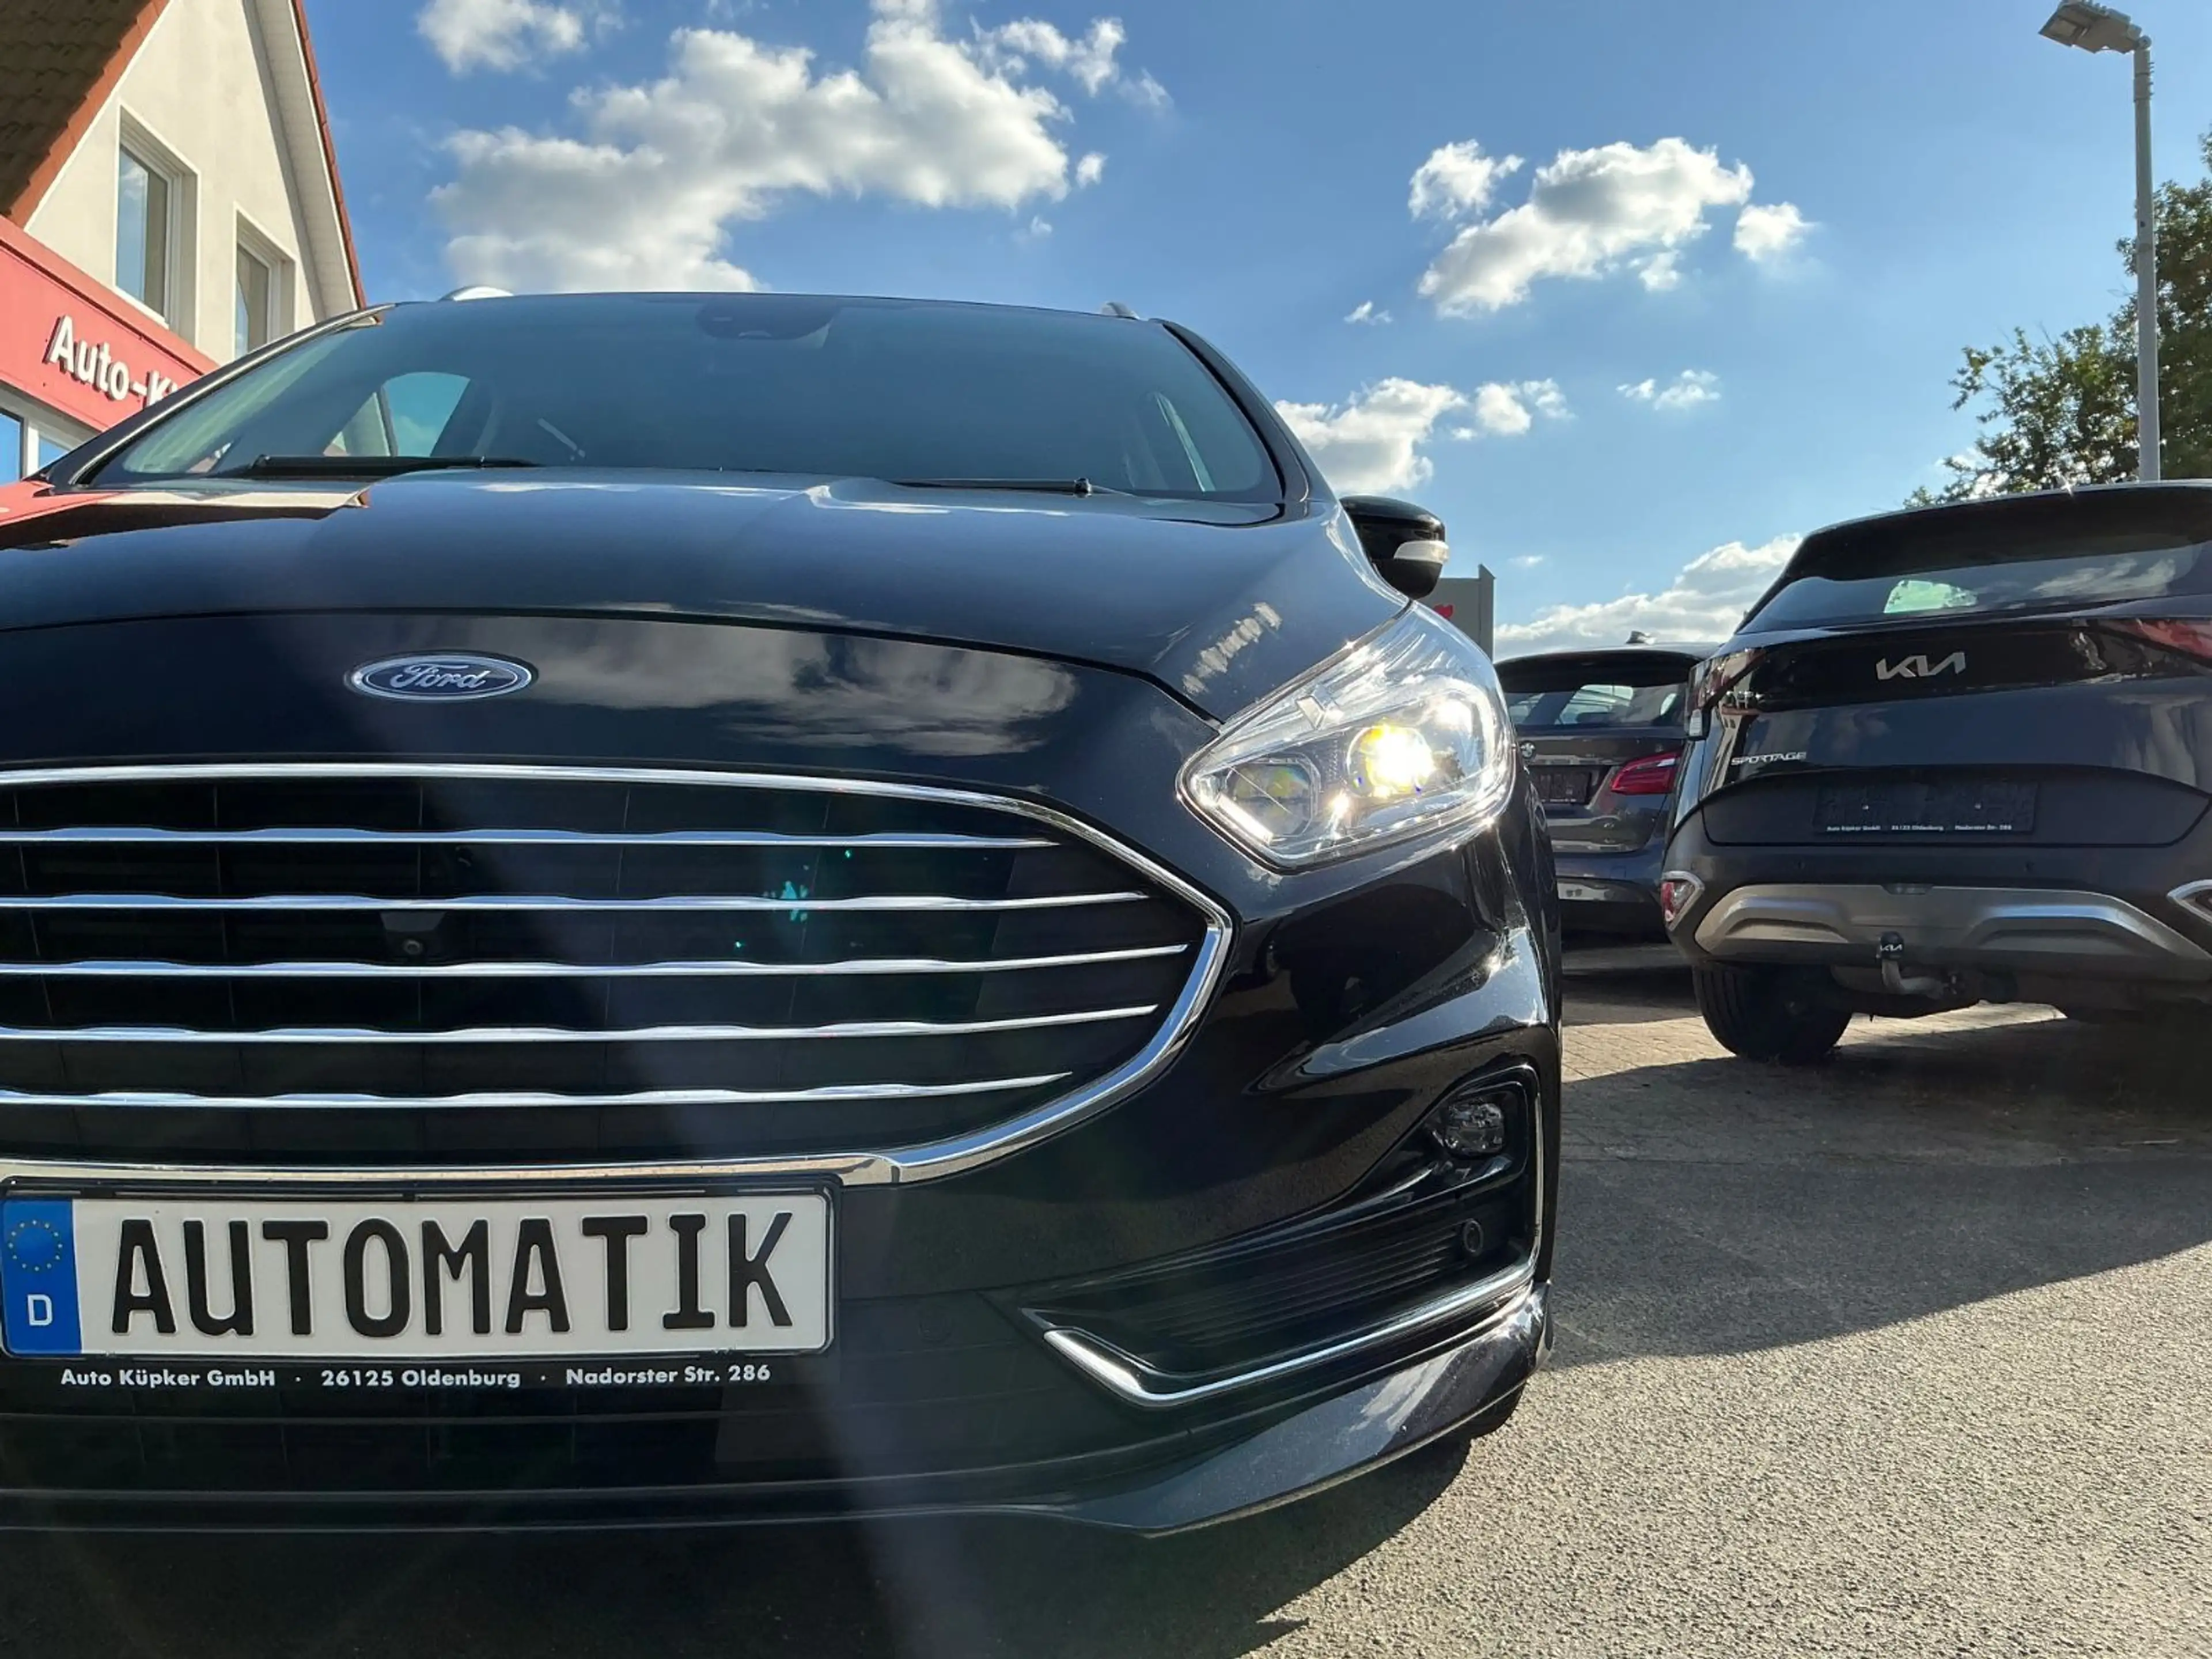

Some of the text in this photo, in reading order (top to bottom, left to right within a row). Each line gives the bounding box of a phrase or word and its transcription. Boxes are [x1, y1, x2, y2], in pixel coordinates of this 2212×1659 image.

[45, 315, 178, 406] Auto-K
[389, 663, 491, 688] Ford
[1876, 652, 1966, 680] KIA
[1730, 751, 1806, 766] SPORTAGE
[112, 1212, 793, 1338] AUTOMATIK
[28, 1294, 53, 1326] D
[60, 1364, 771, 1388] Auto Küpker GmbH 26125 Oldenburg Nadorster Str. 286
